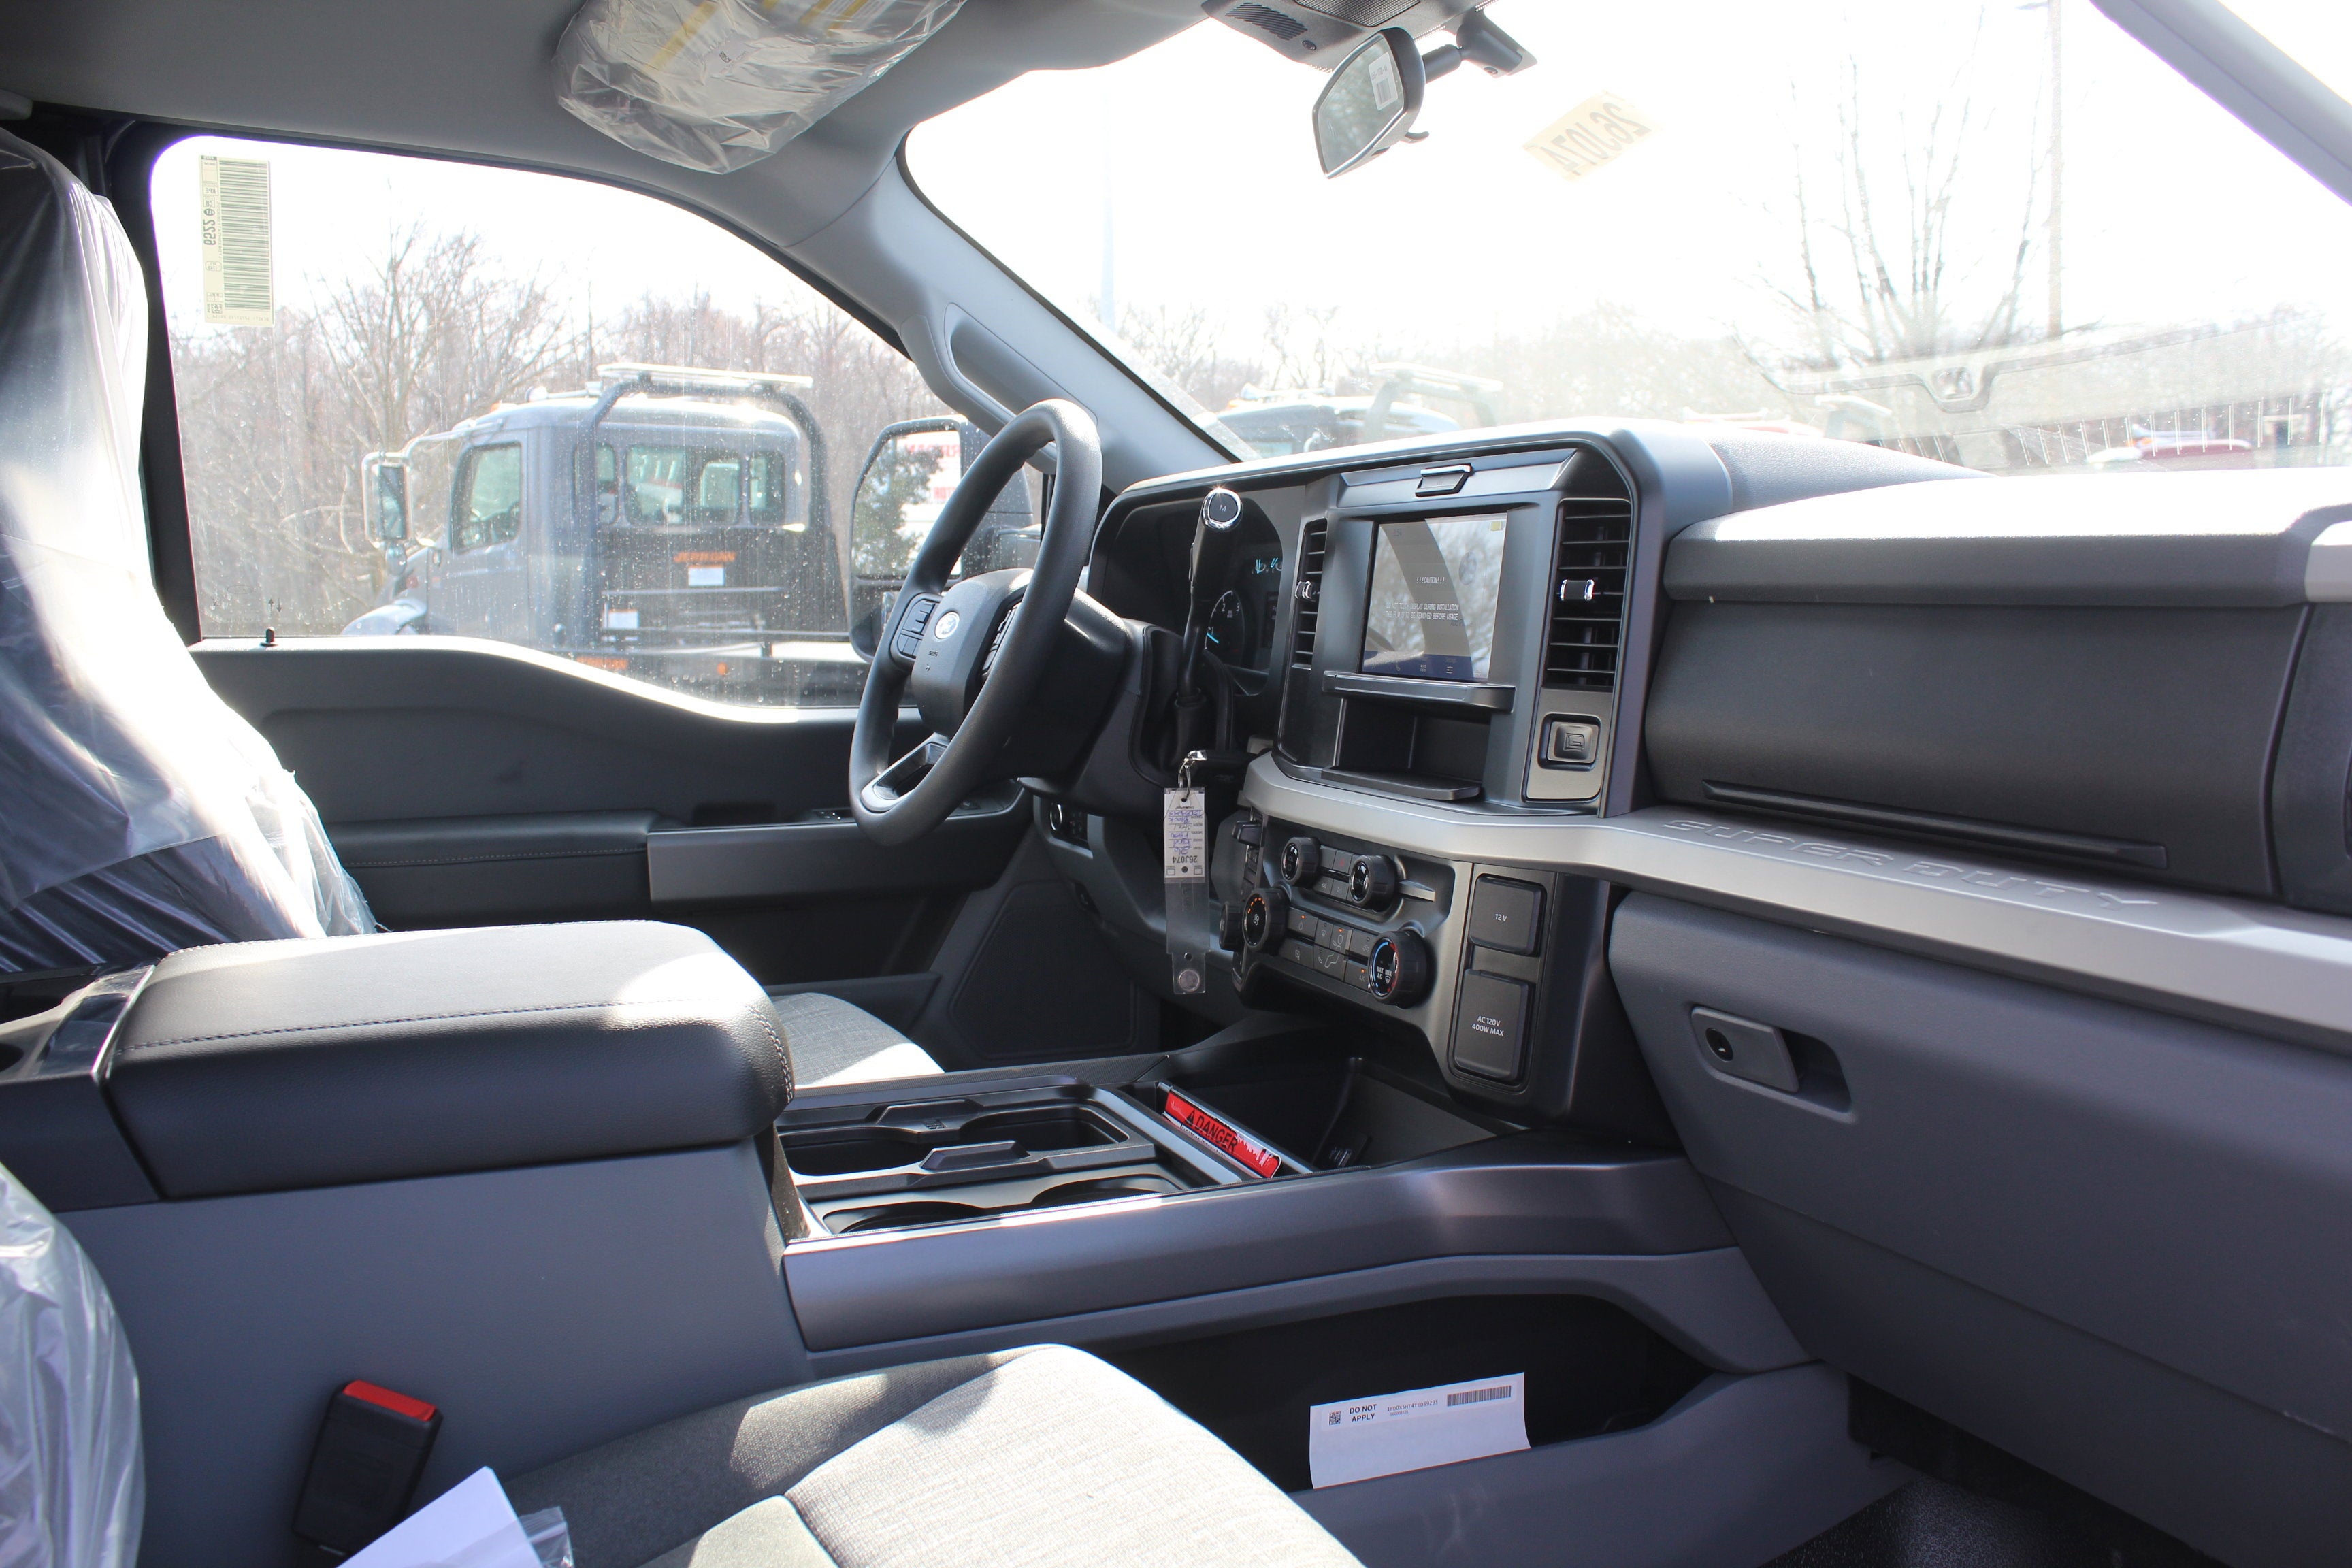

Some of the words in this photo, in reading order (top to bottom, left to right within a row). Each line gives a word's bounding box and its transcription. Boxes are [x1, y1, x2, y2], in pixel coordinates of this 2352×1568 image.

[1172, 855, 1198, 864] 26J074
[1662, 819, 1895, 866] SUPER
[1902, 860, 2158, 911] DUTY
[1477, 1015, 1486, 1024] AC
[1486, 1017, 1501, 1027] 120V
[1472, 1023, 1489, 1033] 400W
[1490, 1026, 1504, 1036] MAX
[1195, 1114, 1238, 1154] DANGER
[1362, 1403, 1377, 1413] NOT
[1352, 1413, 1375, 1422] APPLY
